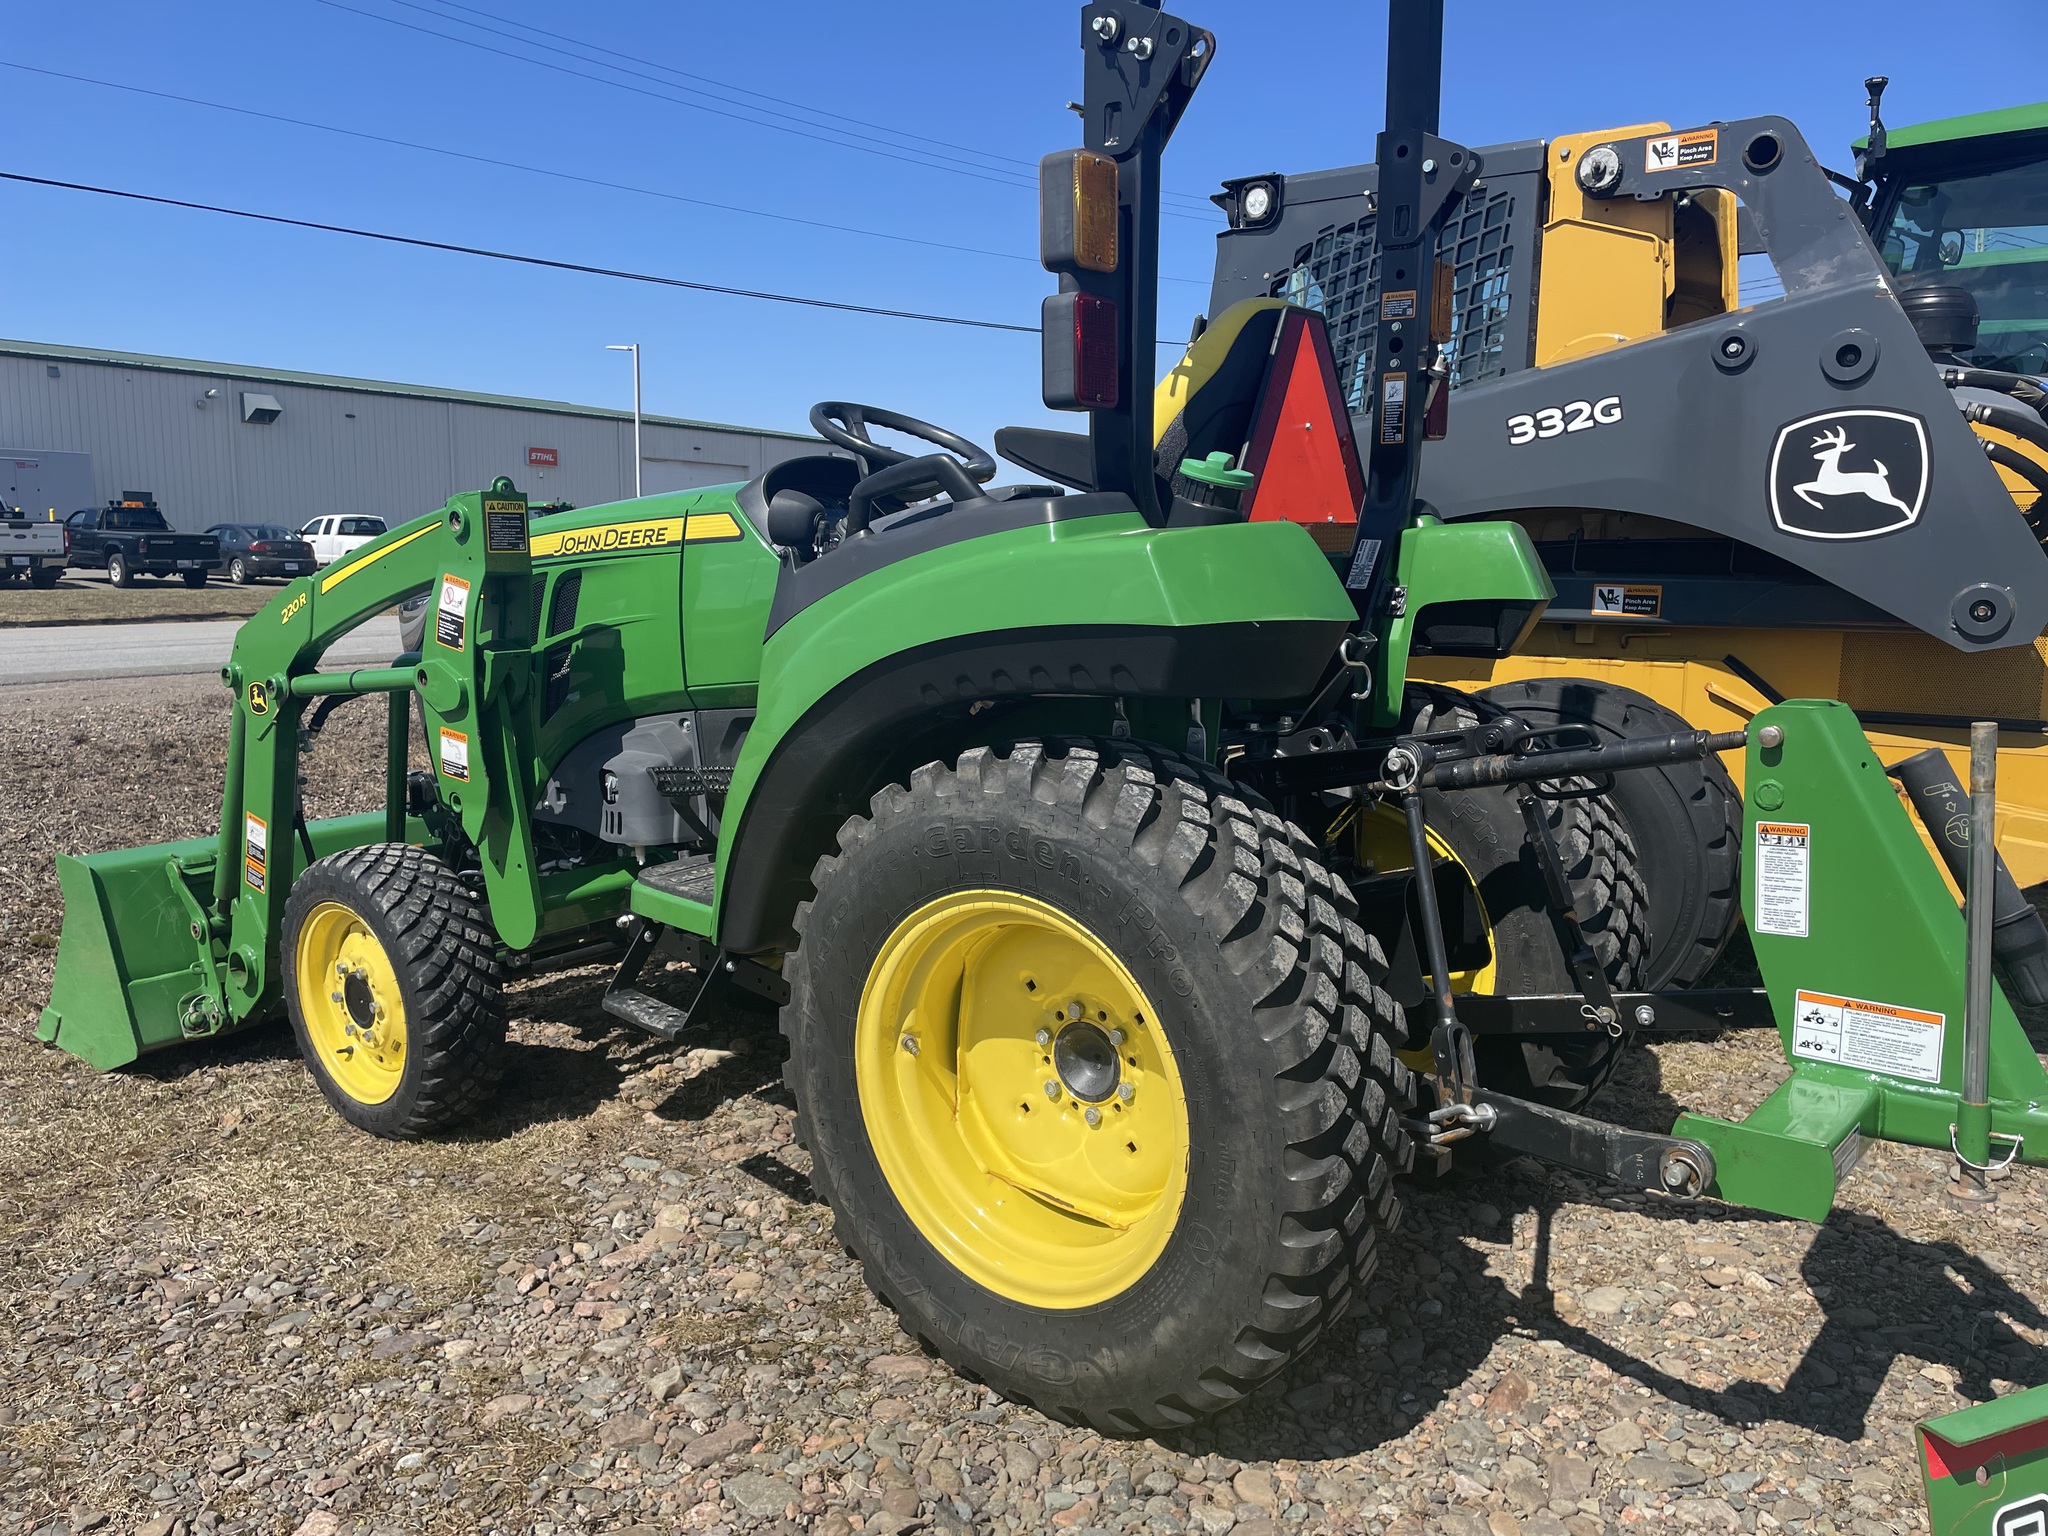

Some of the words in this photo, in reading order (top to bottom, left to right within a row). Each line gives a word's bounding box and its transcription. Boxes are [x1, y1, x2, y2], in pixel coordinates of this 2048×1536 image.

[1687, 133, 1714, 142] WARNING
[1680, 146, 1697, 154] Pinch
[1507, 396, 1622, 445] 332G
[530, 452, 554, 462] STIHL
[497, 502, 524, 510] CAUTION
[554, 534, 602, 554] JOHN
[604, 527, 668, 547] DEERE
[281, 592, 306, 625] 220R
[1770, 826, 1806, 834] WARNING
[1856, 1002, 1897, 1015] WARNING
